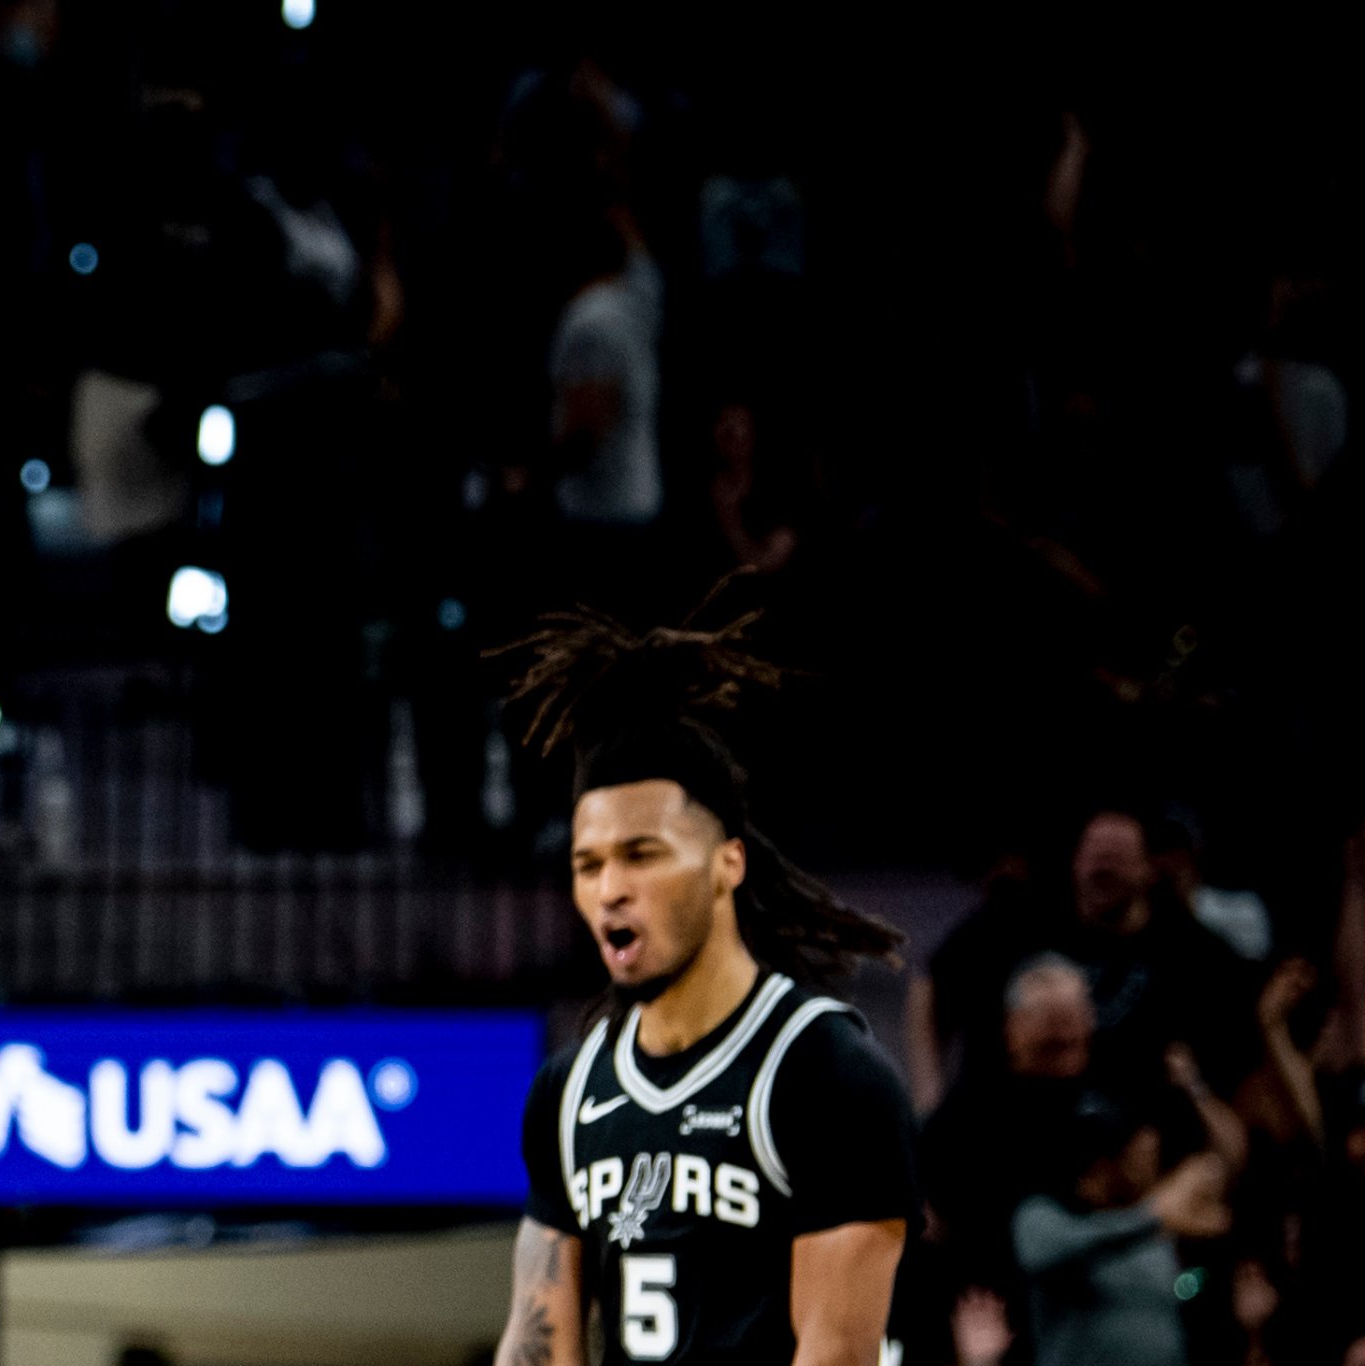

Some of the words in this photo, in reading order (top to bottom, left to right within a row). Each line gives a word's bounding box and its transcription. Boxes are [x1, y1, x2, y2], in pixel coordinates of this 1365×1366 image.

[89, 1057, 388, 1169] USAA
[572, 1152, 760, 1249] SPURS
[620, 1253, 679, 1361] 5
